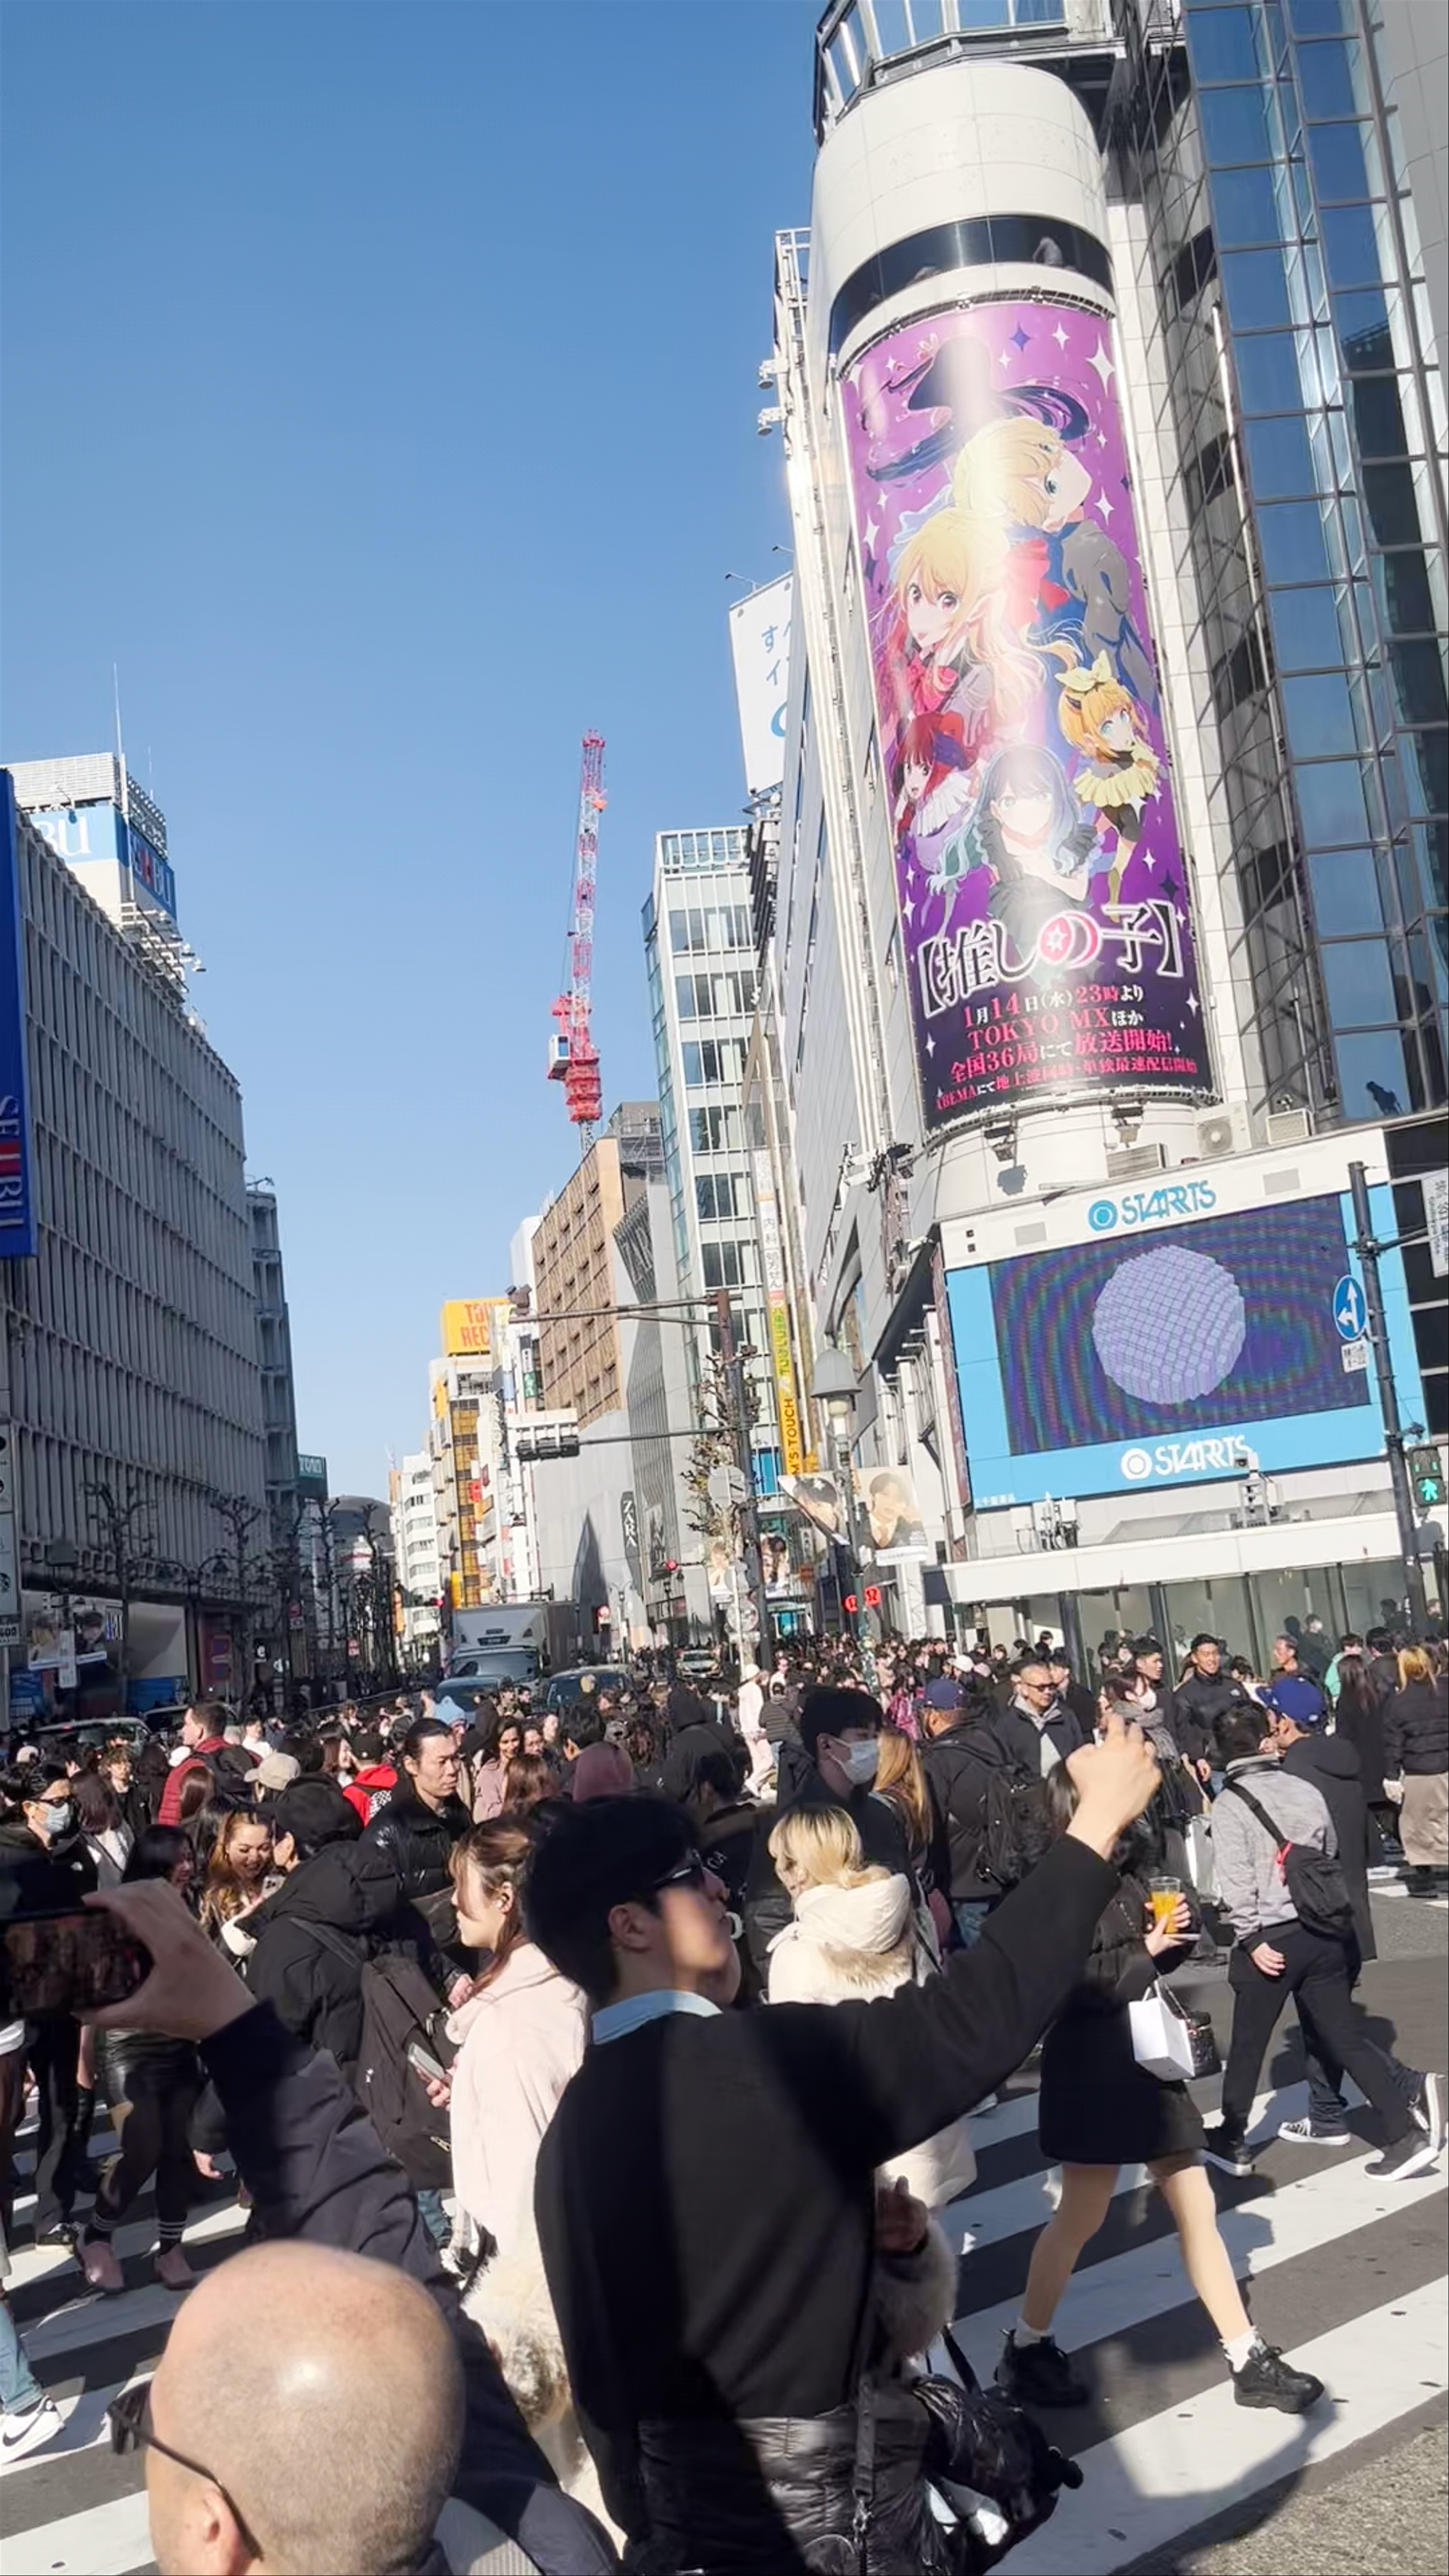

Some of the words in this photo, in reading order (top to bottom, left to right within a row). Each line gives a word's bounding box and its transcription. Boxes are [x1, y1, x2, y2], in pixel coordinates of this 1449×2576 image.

[968, 1013, 1060, 1051] TOKYO
[1121, 1180, 1217, 1225] STARTS
[784, 1398, 798, 1447] TOUCH
[623, 1499, 637, 1547] ZARA
